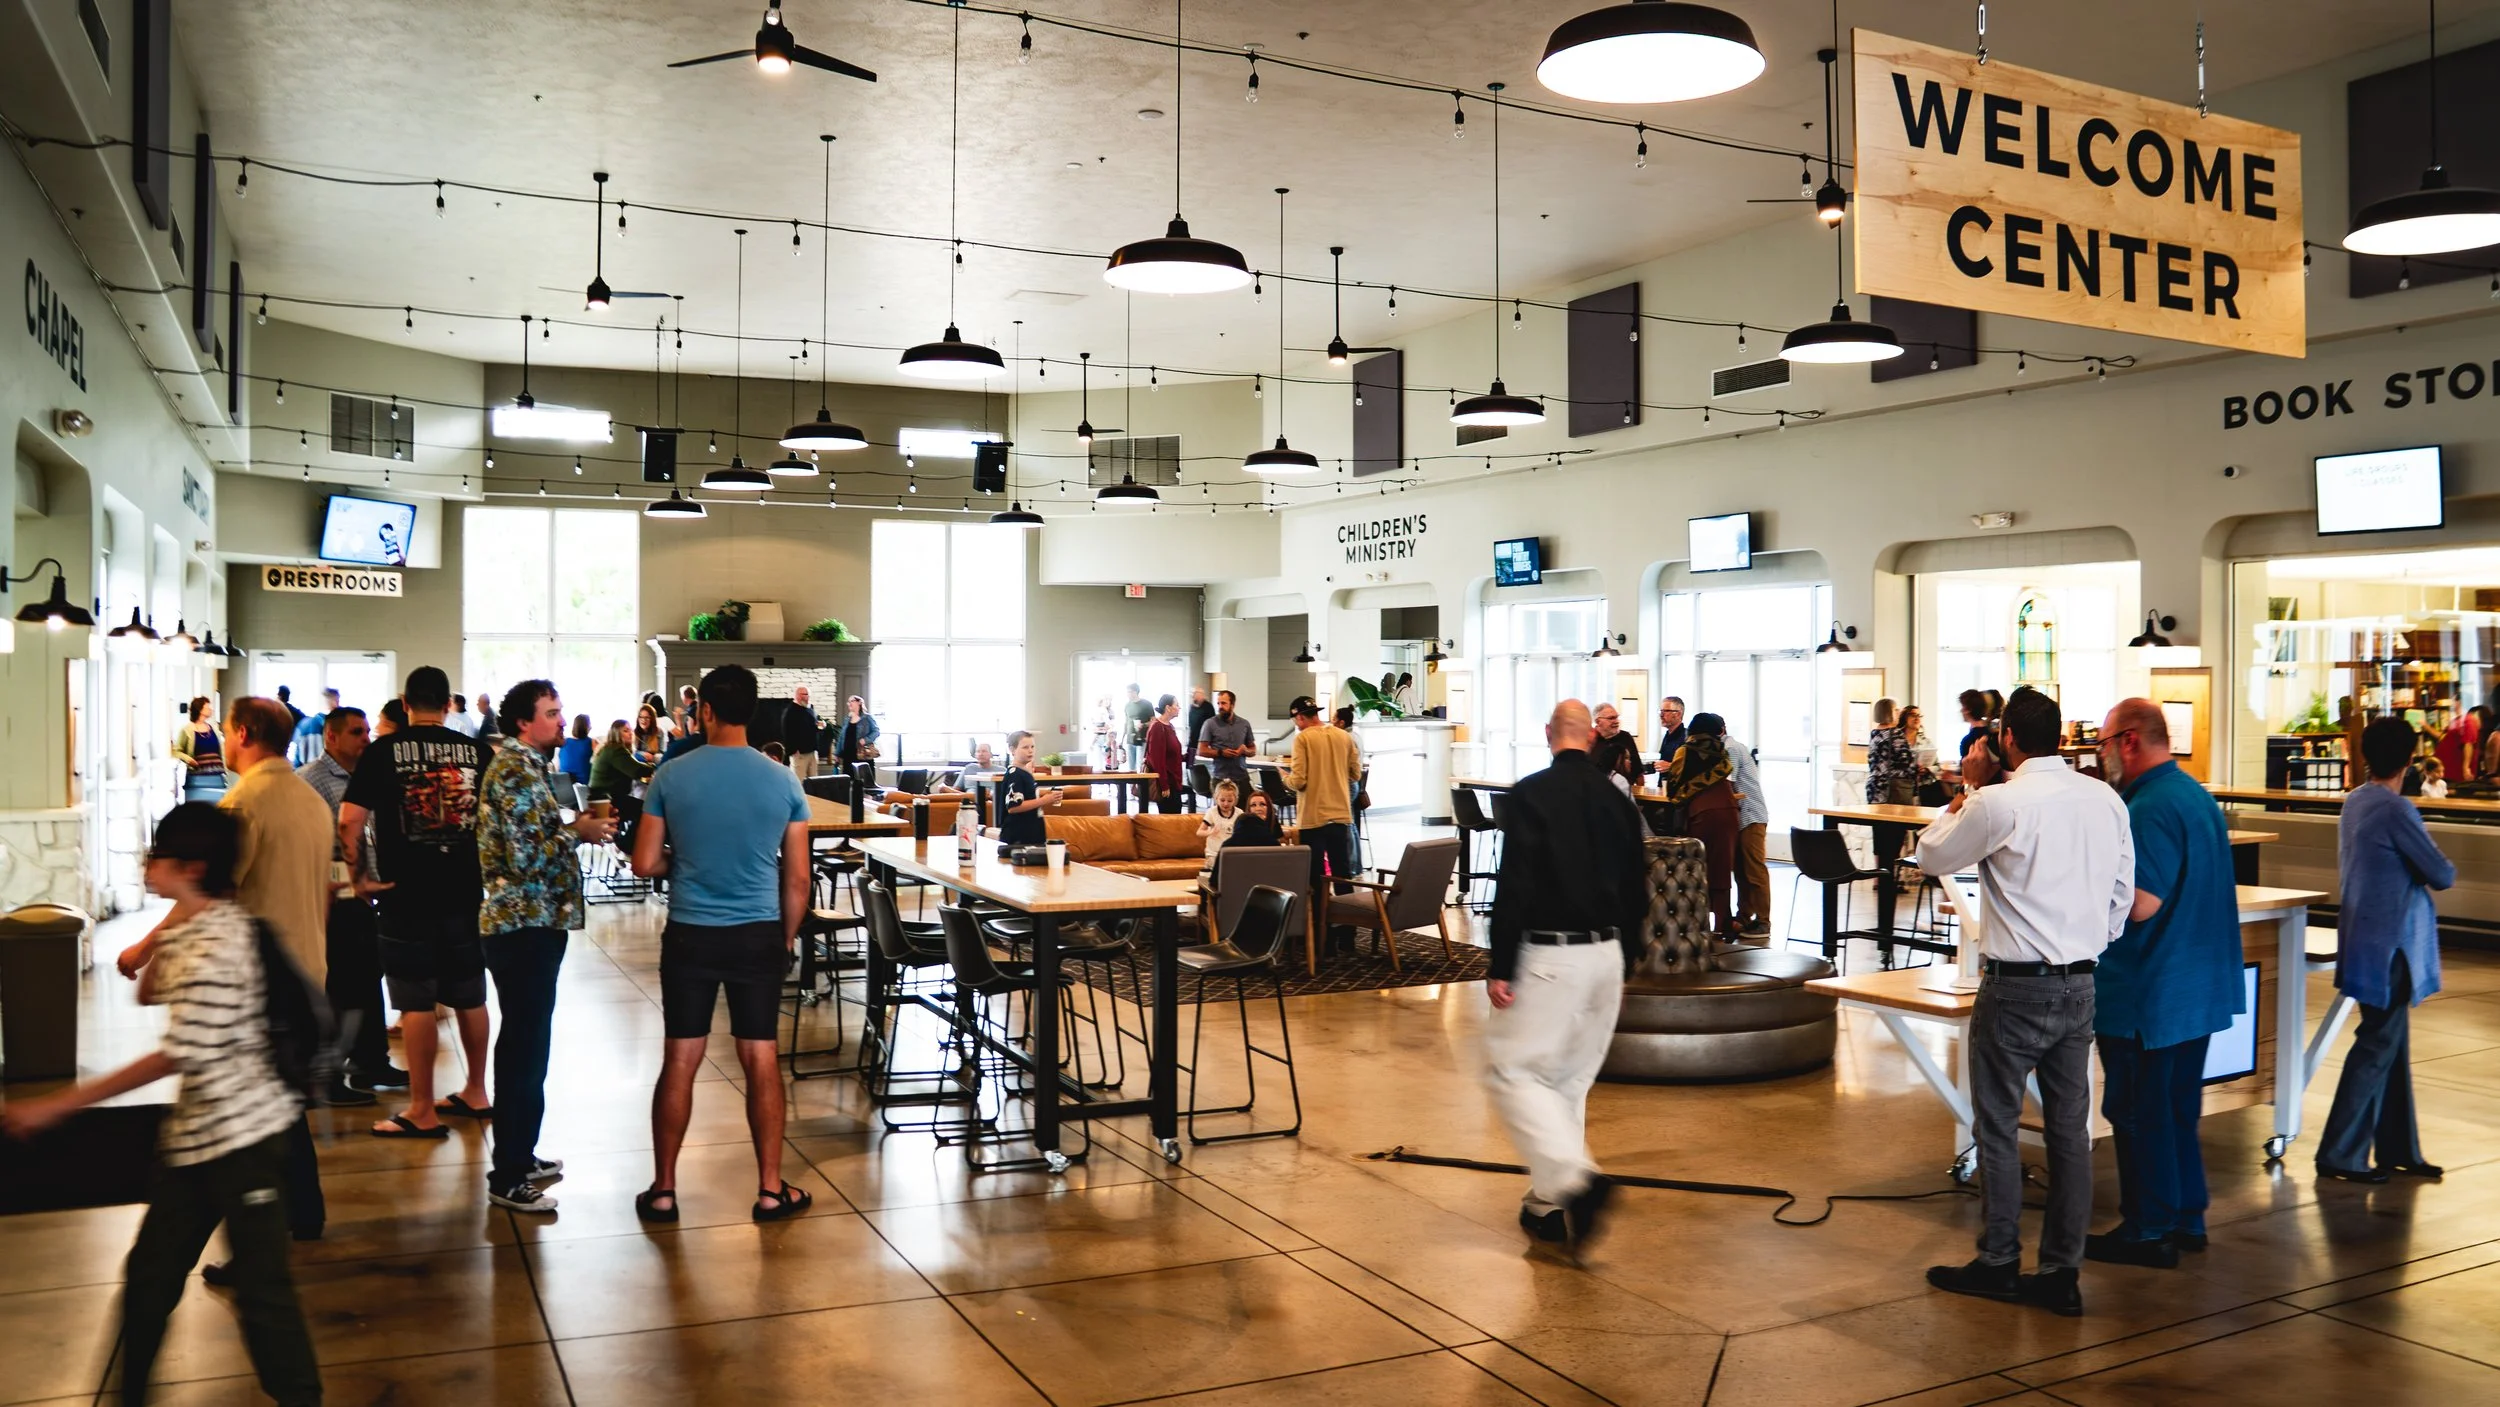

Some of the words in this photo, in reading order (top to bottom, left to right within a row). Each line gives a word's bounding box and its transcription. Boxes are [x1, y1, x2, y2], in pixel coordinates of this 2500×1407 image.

[1891, 72, 2278, 221] WELCOME
[1946, 205, 2241, 319] CENTER
[25, 257, 87, 394] CHAPEL
[2223, 379, 2355, 430] BOOK
[2384, 359, 2500, 409] STO
[1338, 514, 1427, 543] CHILDREN'S
[1346, 538, 1416, 564] MINISTRY
[284, 570, 397, 592] RESTROOMS
[393, 741, 420, 763] GOD
